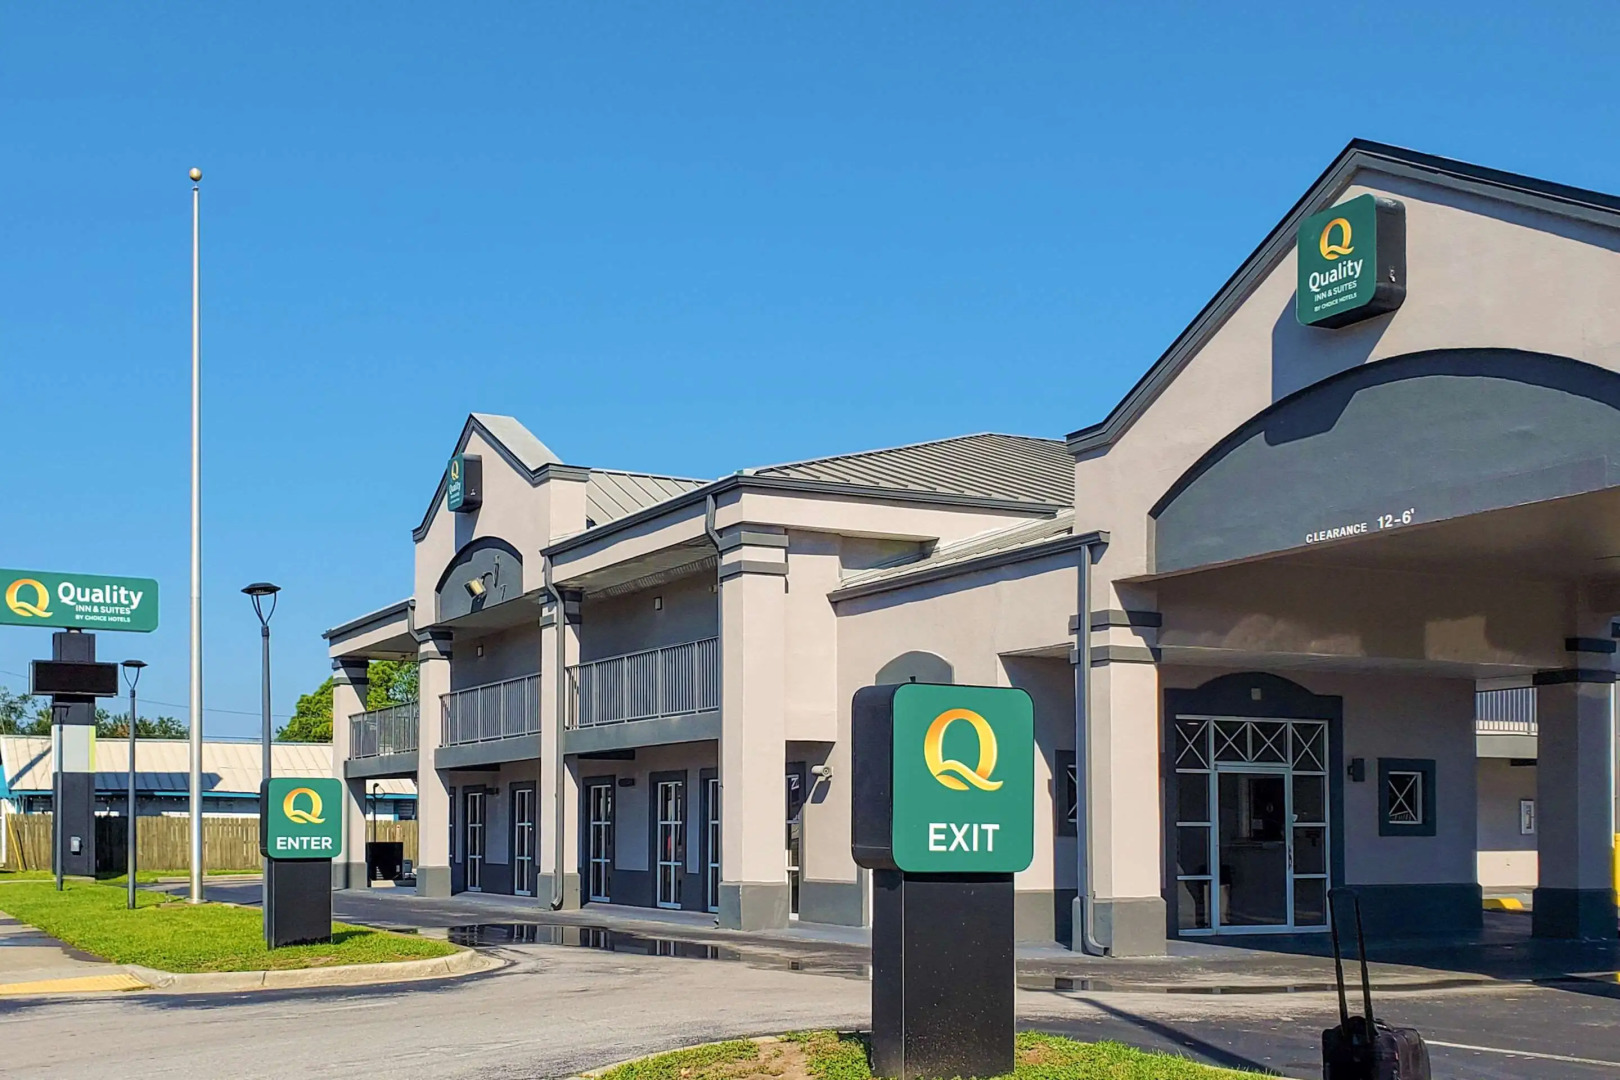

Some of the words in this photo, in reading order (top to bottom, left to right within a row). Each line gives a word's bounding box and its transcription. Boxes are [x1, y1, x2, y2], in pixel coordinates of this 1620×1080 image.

[1309, 259, 1363, 292] Quality
[1314, 291, 1327, 302] INN
[1327, 289, 1333, 297] &
[1333, 280, 1357, 296] SUITES
[1321, 298, 1338, 309] CHOICE
[1338, 292, 1357, 303] HOTELS
[1305, 522, 1367, 543] CLEARANCE
[57, 582, 143, 609] Quality
[75, 604, 92, 613] INN
[92, 605, 99, 613] &
[100, 606, 131, 615] SUITES
[276, 836, 332, 850] ENTER
[928, 823, 1000, 852] EXIT
